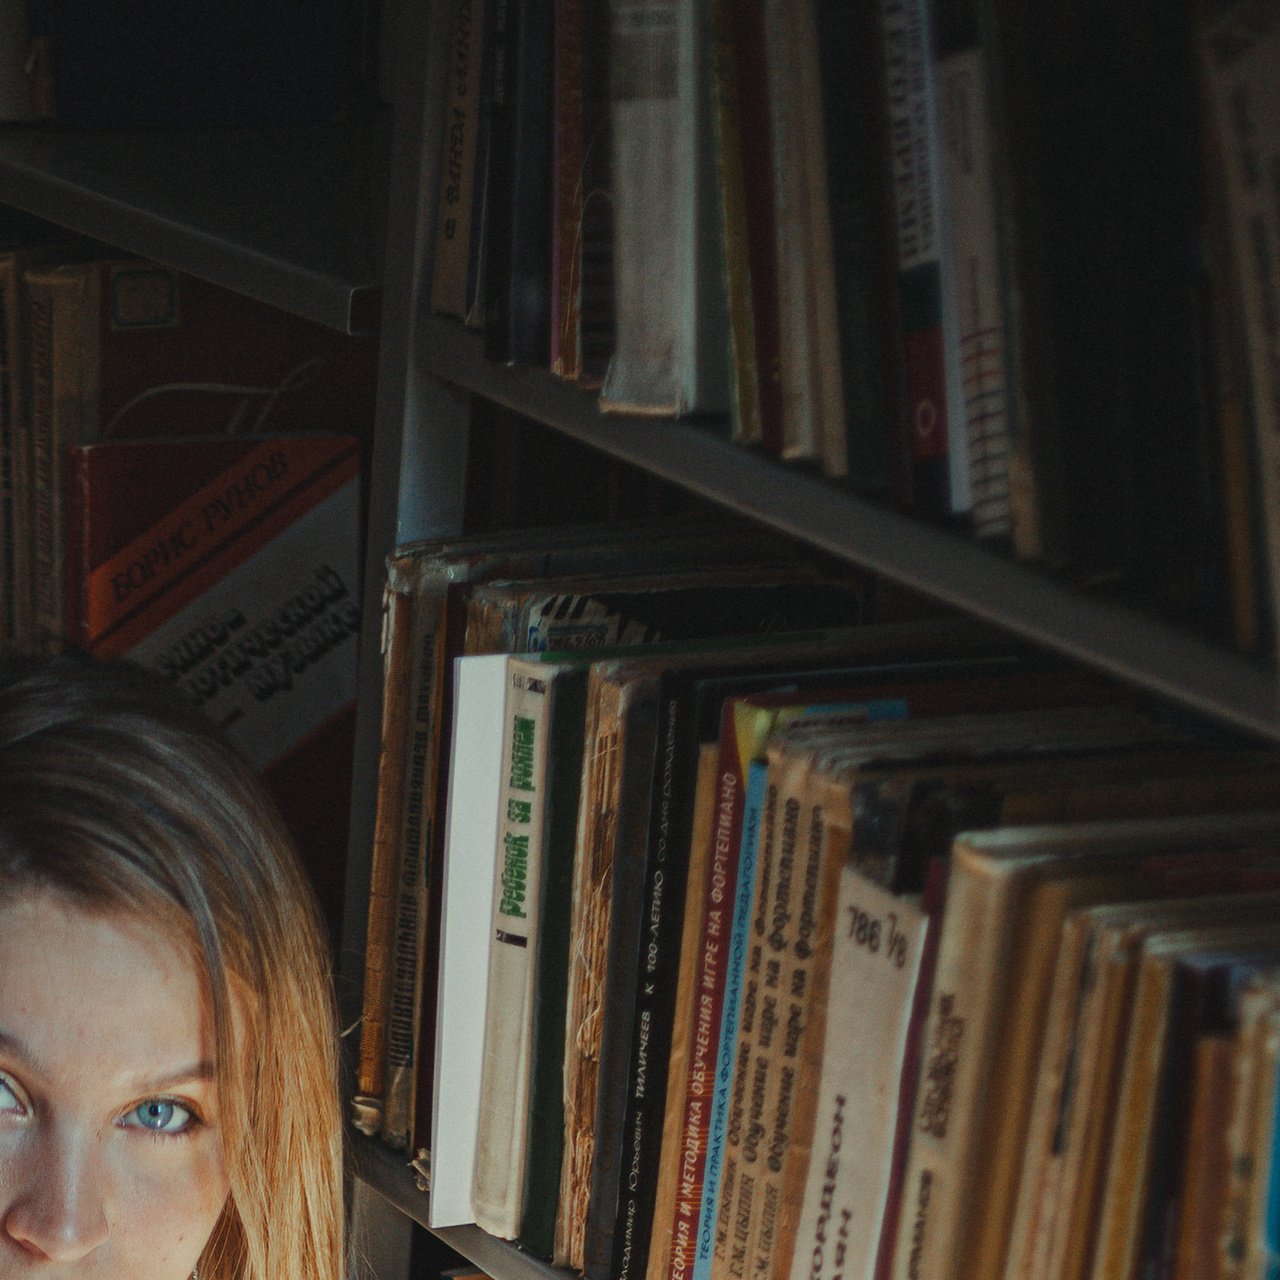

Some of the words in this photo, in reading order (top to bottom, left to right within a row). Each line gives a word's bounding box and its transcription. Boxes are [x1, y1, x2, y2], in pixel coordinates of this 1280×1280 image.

[504, 798, 529, 825] за
[709, 774, 735, 904] ФОРТЕПИАНО
[736, 809, 759, 926] ПЕДАГОГИКИ
[646, 872, 664, 972] 100-ЛЕТИЮ
[706, 910, 720, 937] НА
[701, 944, 717, 990] ИГРЕ
[718, 931, 745, 1083] ФОРТЕПИАННОЙ
[765, 961, 781, 989] на
[790, 968, 806, 996] на
[634, 1012, 651, 1099] ТИЛИЧЕЕВ
[690, 997, 711, 1095] ОБУЧЕНИЯ
[728, 1042, 752, 1147] Обучение
[741, 980, 759, 1034] игре
[750, 946, 761, 974] на
[759, 996, 780, 1049] игре
[782, 1004, 804, 1057] игре
[679, 1102, 700, 1197] МЕТОДИКА
[707, 1090, 727, 1176] ПРАКТИКА
[745, 1056, 771, 1163] Обучение
[766, 1065, 794, 1172] Обучение
[626, 1112, 643, 1192] Юрьевич
[705, 1181, 717, 1193] И
[677, 1201, 690, 1216] И
[698, 1198, 715, 1260] ТЕОРИЯ
